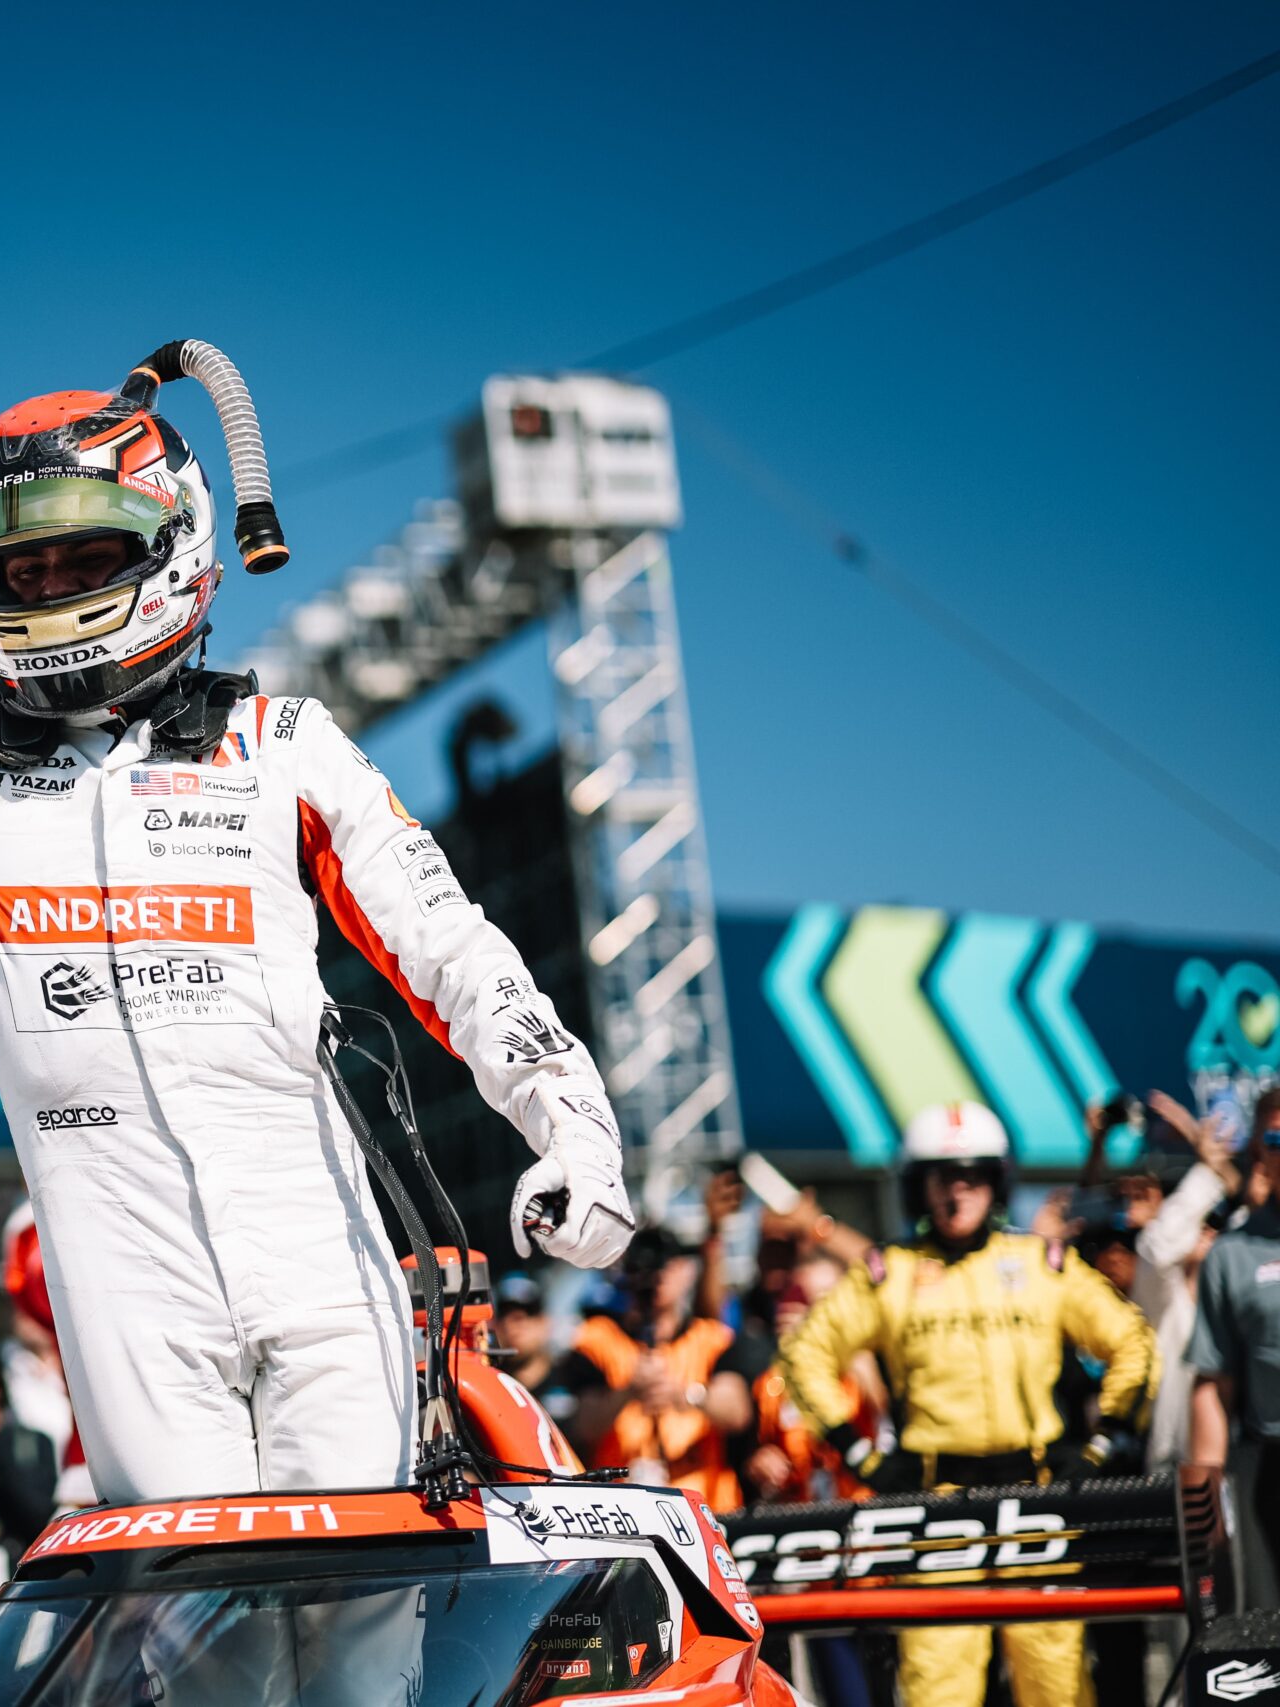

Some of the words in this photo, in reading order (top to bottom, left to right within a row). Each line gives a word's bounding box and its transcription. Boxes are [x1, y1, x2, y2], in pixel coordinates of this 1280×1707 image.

[38, 467, 62, 475] HOME
[123, 475, 170, 504] ANDRETTI
[142, 596, 165, 616] BELL
[13, 644, 111, 671] HONDA
[9, 773, 76, 792] YAZAKI
[175, 777, 195, 790] 27
[204, 780, 257, 794] Kirkwood
[177, 810, 247, 832] MAPEI
[171, 842, 252, 860] blackpoint
[8, 896, 241, 933] ANDRETTI
[111, 958, 224, 989] PreFab
[118, 991, 162, 1009] HOME
[194, 1005, 210, 1015] BY
[35, 1106, 118, 1131] sparco
[31, 1503, 340, 1555] ANDRETTI
[551, 1503, 640, 1539] PreFab
[729, 1498, 1070, 1583] reFab
[549, 1613, 601, 1628] PreFab
[540, 1637, 603, 1651] GAINBRIDGE
[546, 1662, 585, 1675] bryant
